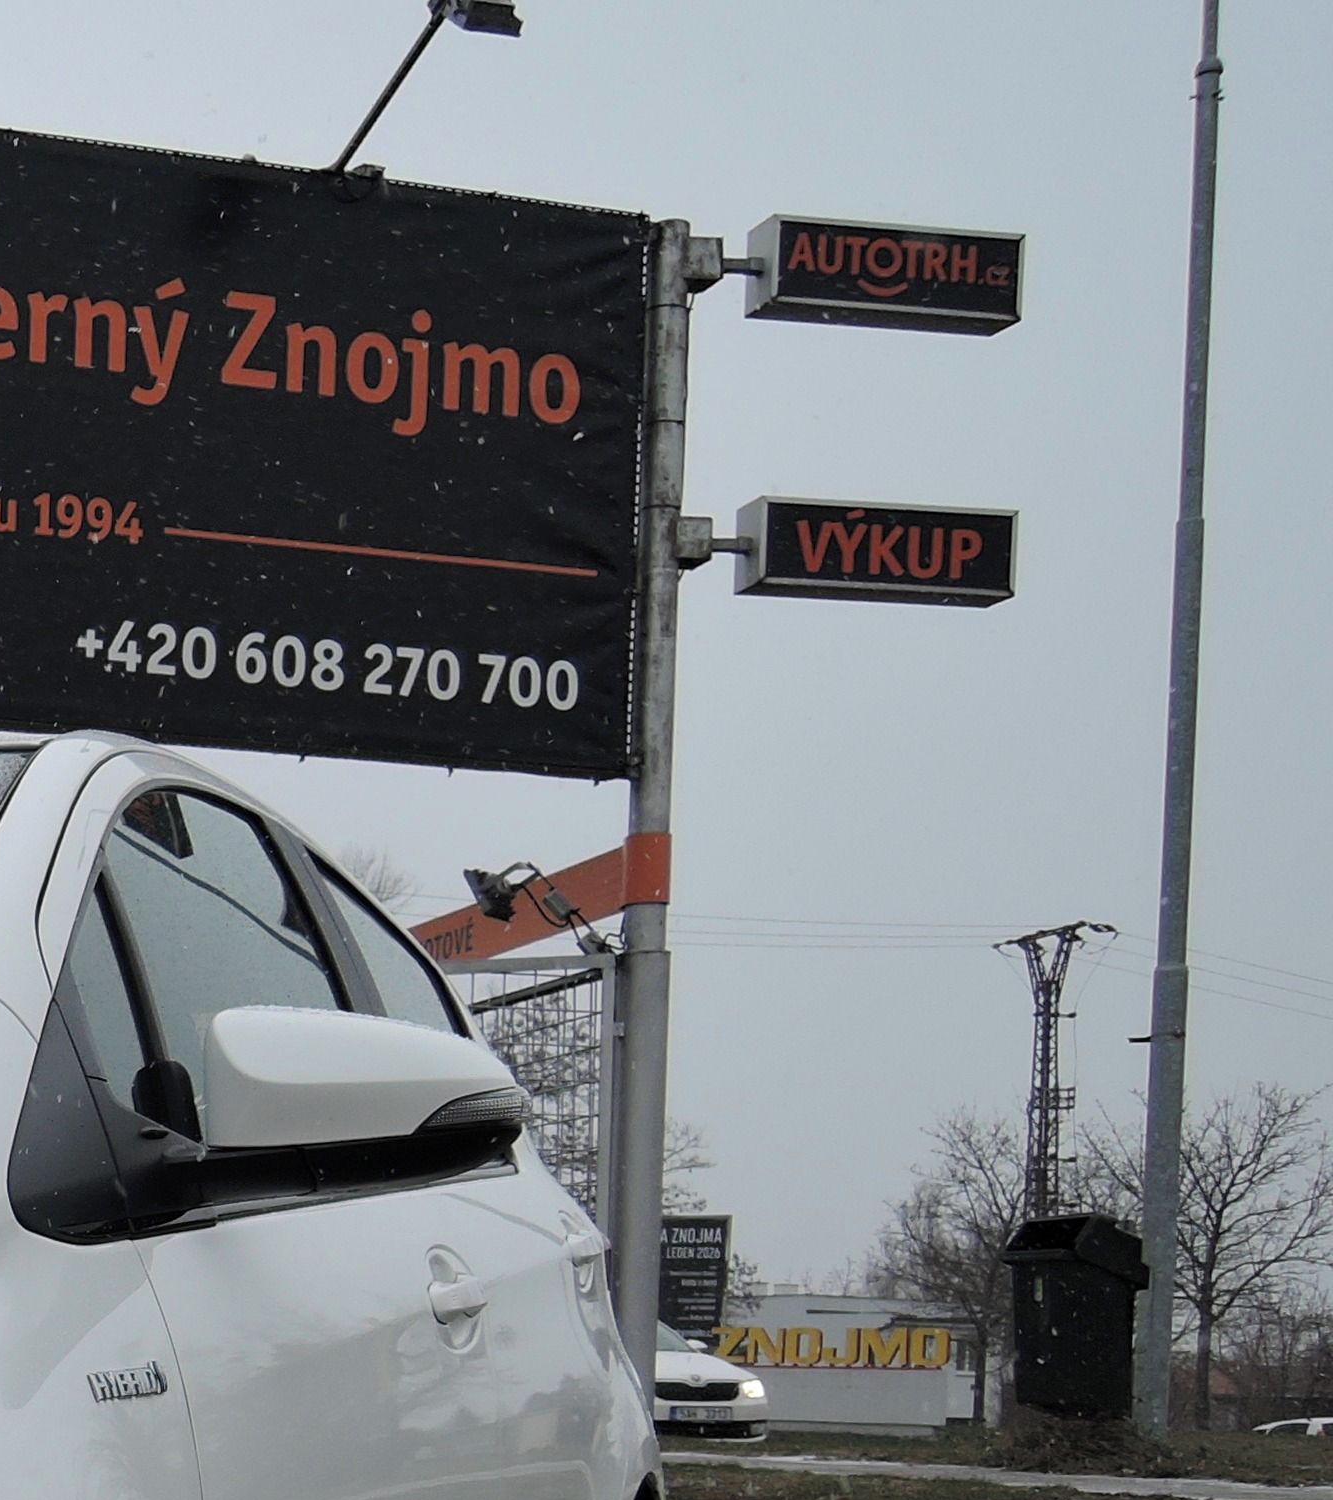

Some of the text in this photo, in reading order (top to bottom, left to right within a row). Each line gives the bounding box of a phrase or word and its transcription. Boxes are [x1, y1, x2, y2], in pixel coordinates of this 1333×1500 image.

[787, 231, 1011, 287] AUTOTRH.cz
[221, 290, 581, 437] Znojmo
[34, 493, 144, 546] 1994
[795, 508, 983, 579] VÝKUP
[75, 619, 580, 712] +420 608 270 700
[672, 1226, 722, 1244] ZNOJMA
[712, 1326, 952, 1368] ZNOJMO
